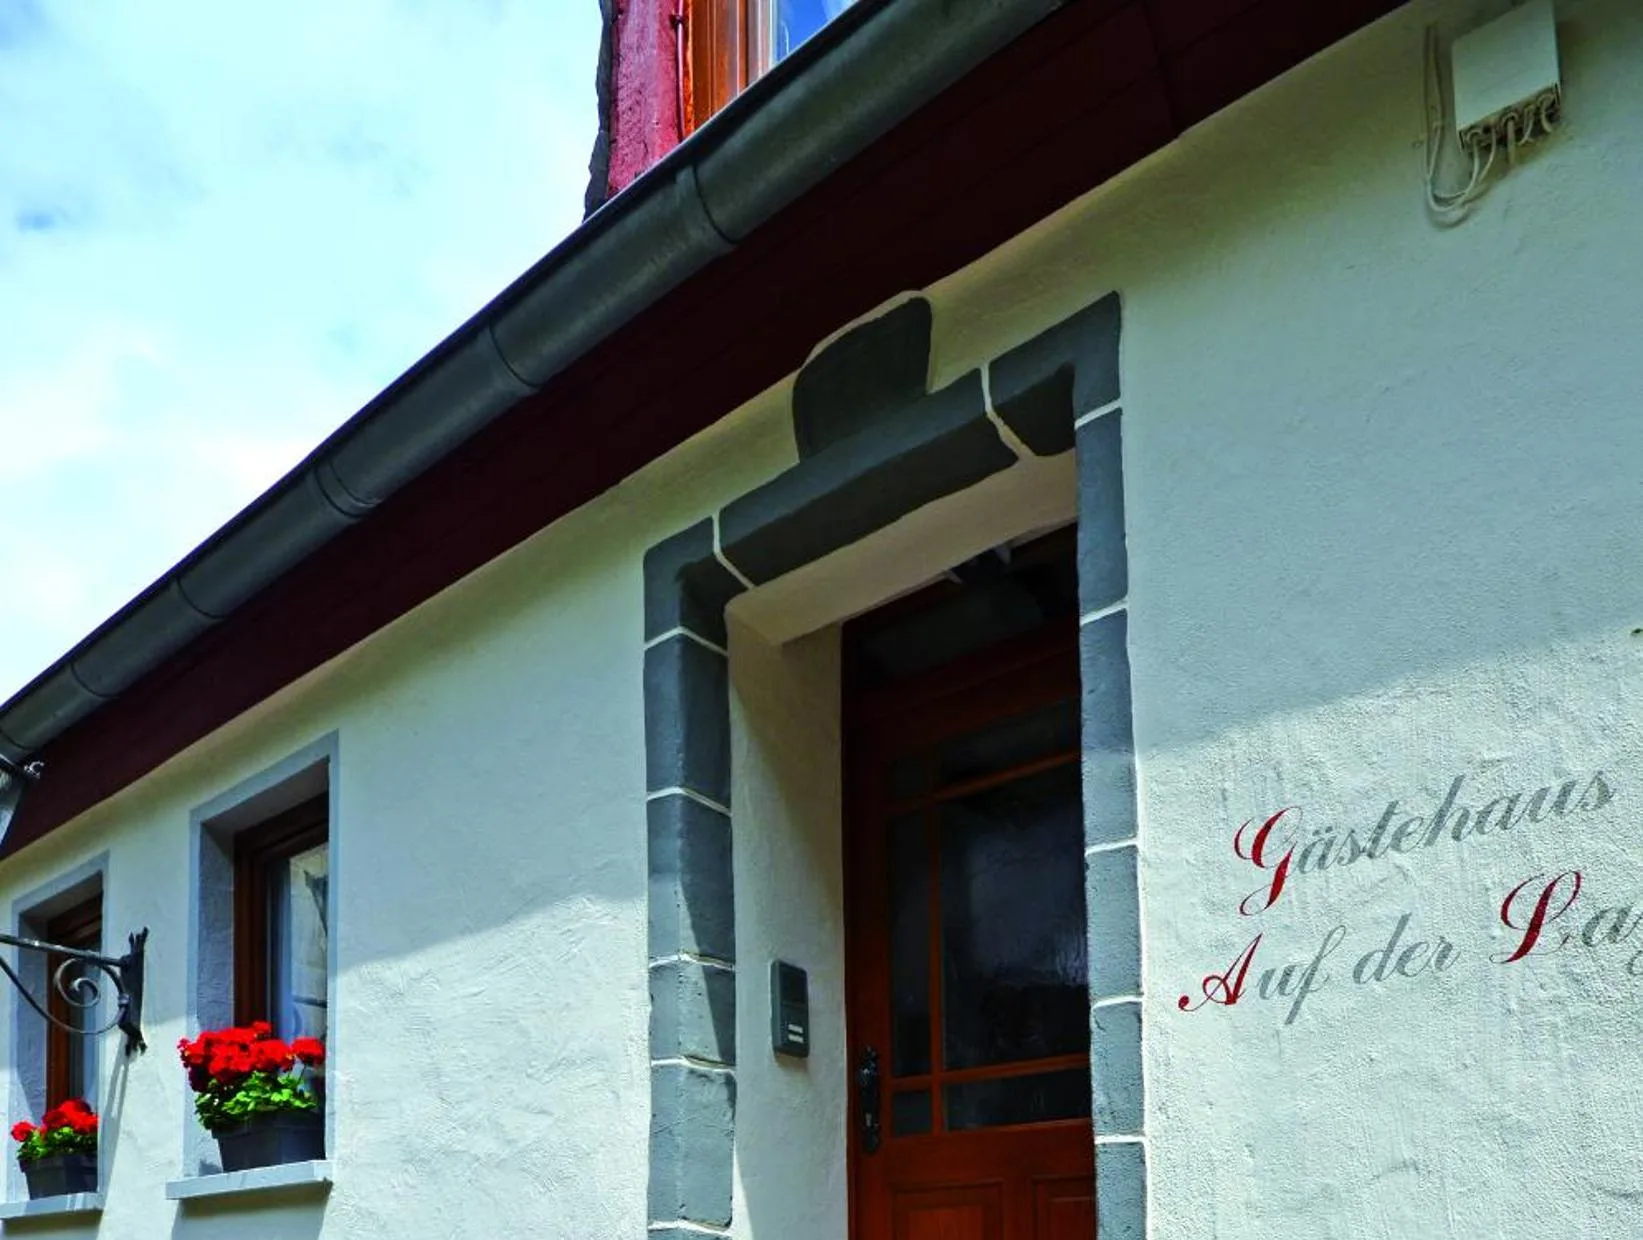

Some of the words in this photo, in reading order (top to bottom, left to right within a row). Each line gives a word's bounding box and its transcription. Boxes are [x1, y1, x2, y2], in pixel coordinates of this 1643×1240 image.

[1234, 770, 1616, 916] Gästehaus
[1178, 924, 1347, 1026] Auf
[1352, 912, 1460, 985] der
[1489, 870, 1643, 977] La
